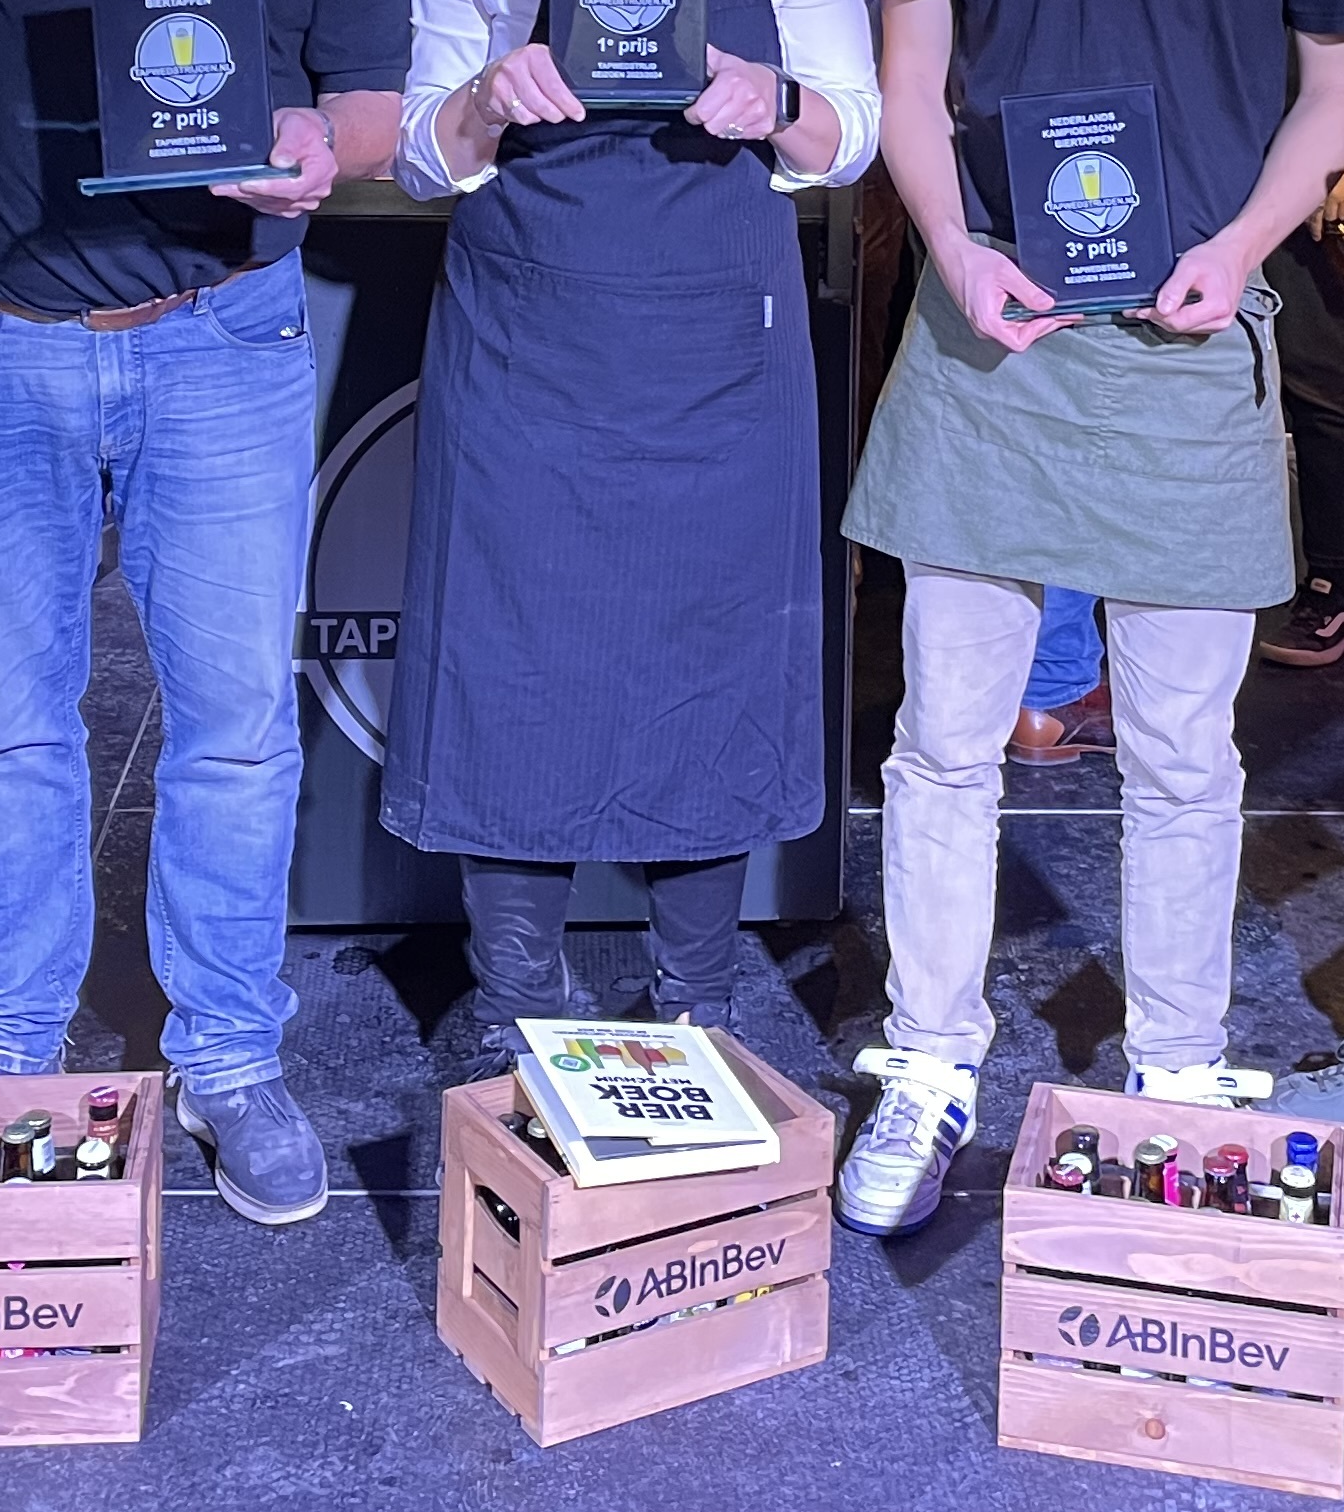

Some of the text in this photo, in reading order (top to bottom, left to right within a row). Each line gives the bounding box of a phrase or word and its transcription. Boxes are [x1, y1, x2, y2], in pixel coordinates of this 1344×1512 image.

[618, 37, 658, 56] prijs
[176, 108, 219, 130] prijs
[1049, 112, 1115, 126] NEDERLANDS
[1042, 122, 1125, 138] KAMPIOENSCHAP
[1055, 134, 1115, 148] BIERTAPPEN
[1088, 239, 1128, 259] prijs
[311, 618, 401, 654] TAP
[594, 1074, 693, 1086] MET SCHUIM
[588, 1083, 714, 1104] BOEK
[612, 1101, 714, 1121] BIER
[635, 1238, 787, 1306] ABInBev
[1105, 1314, 1290, 1372] ABInBev
